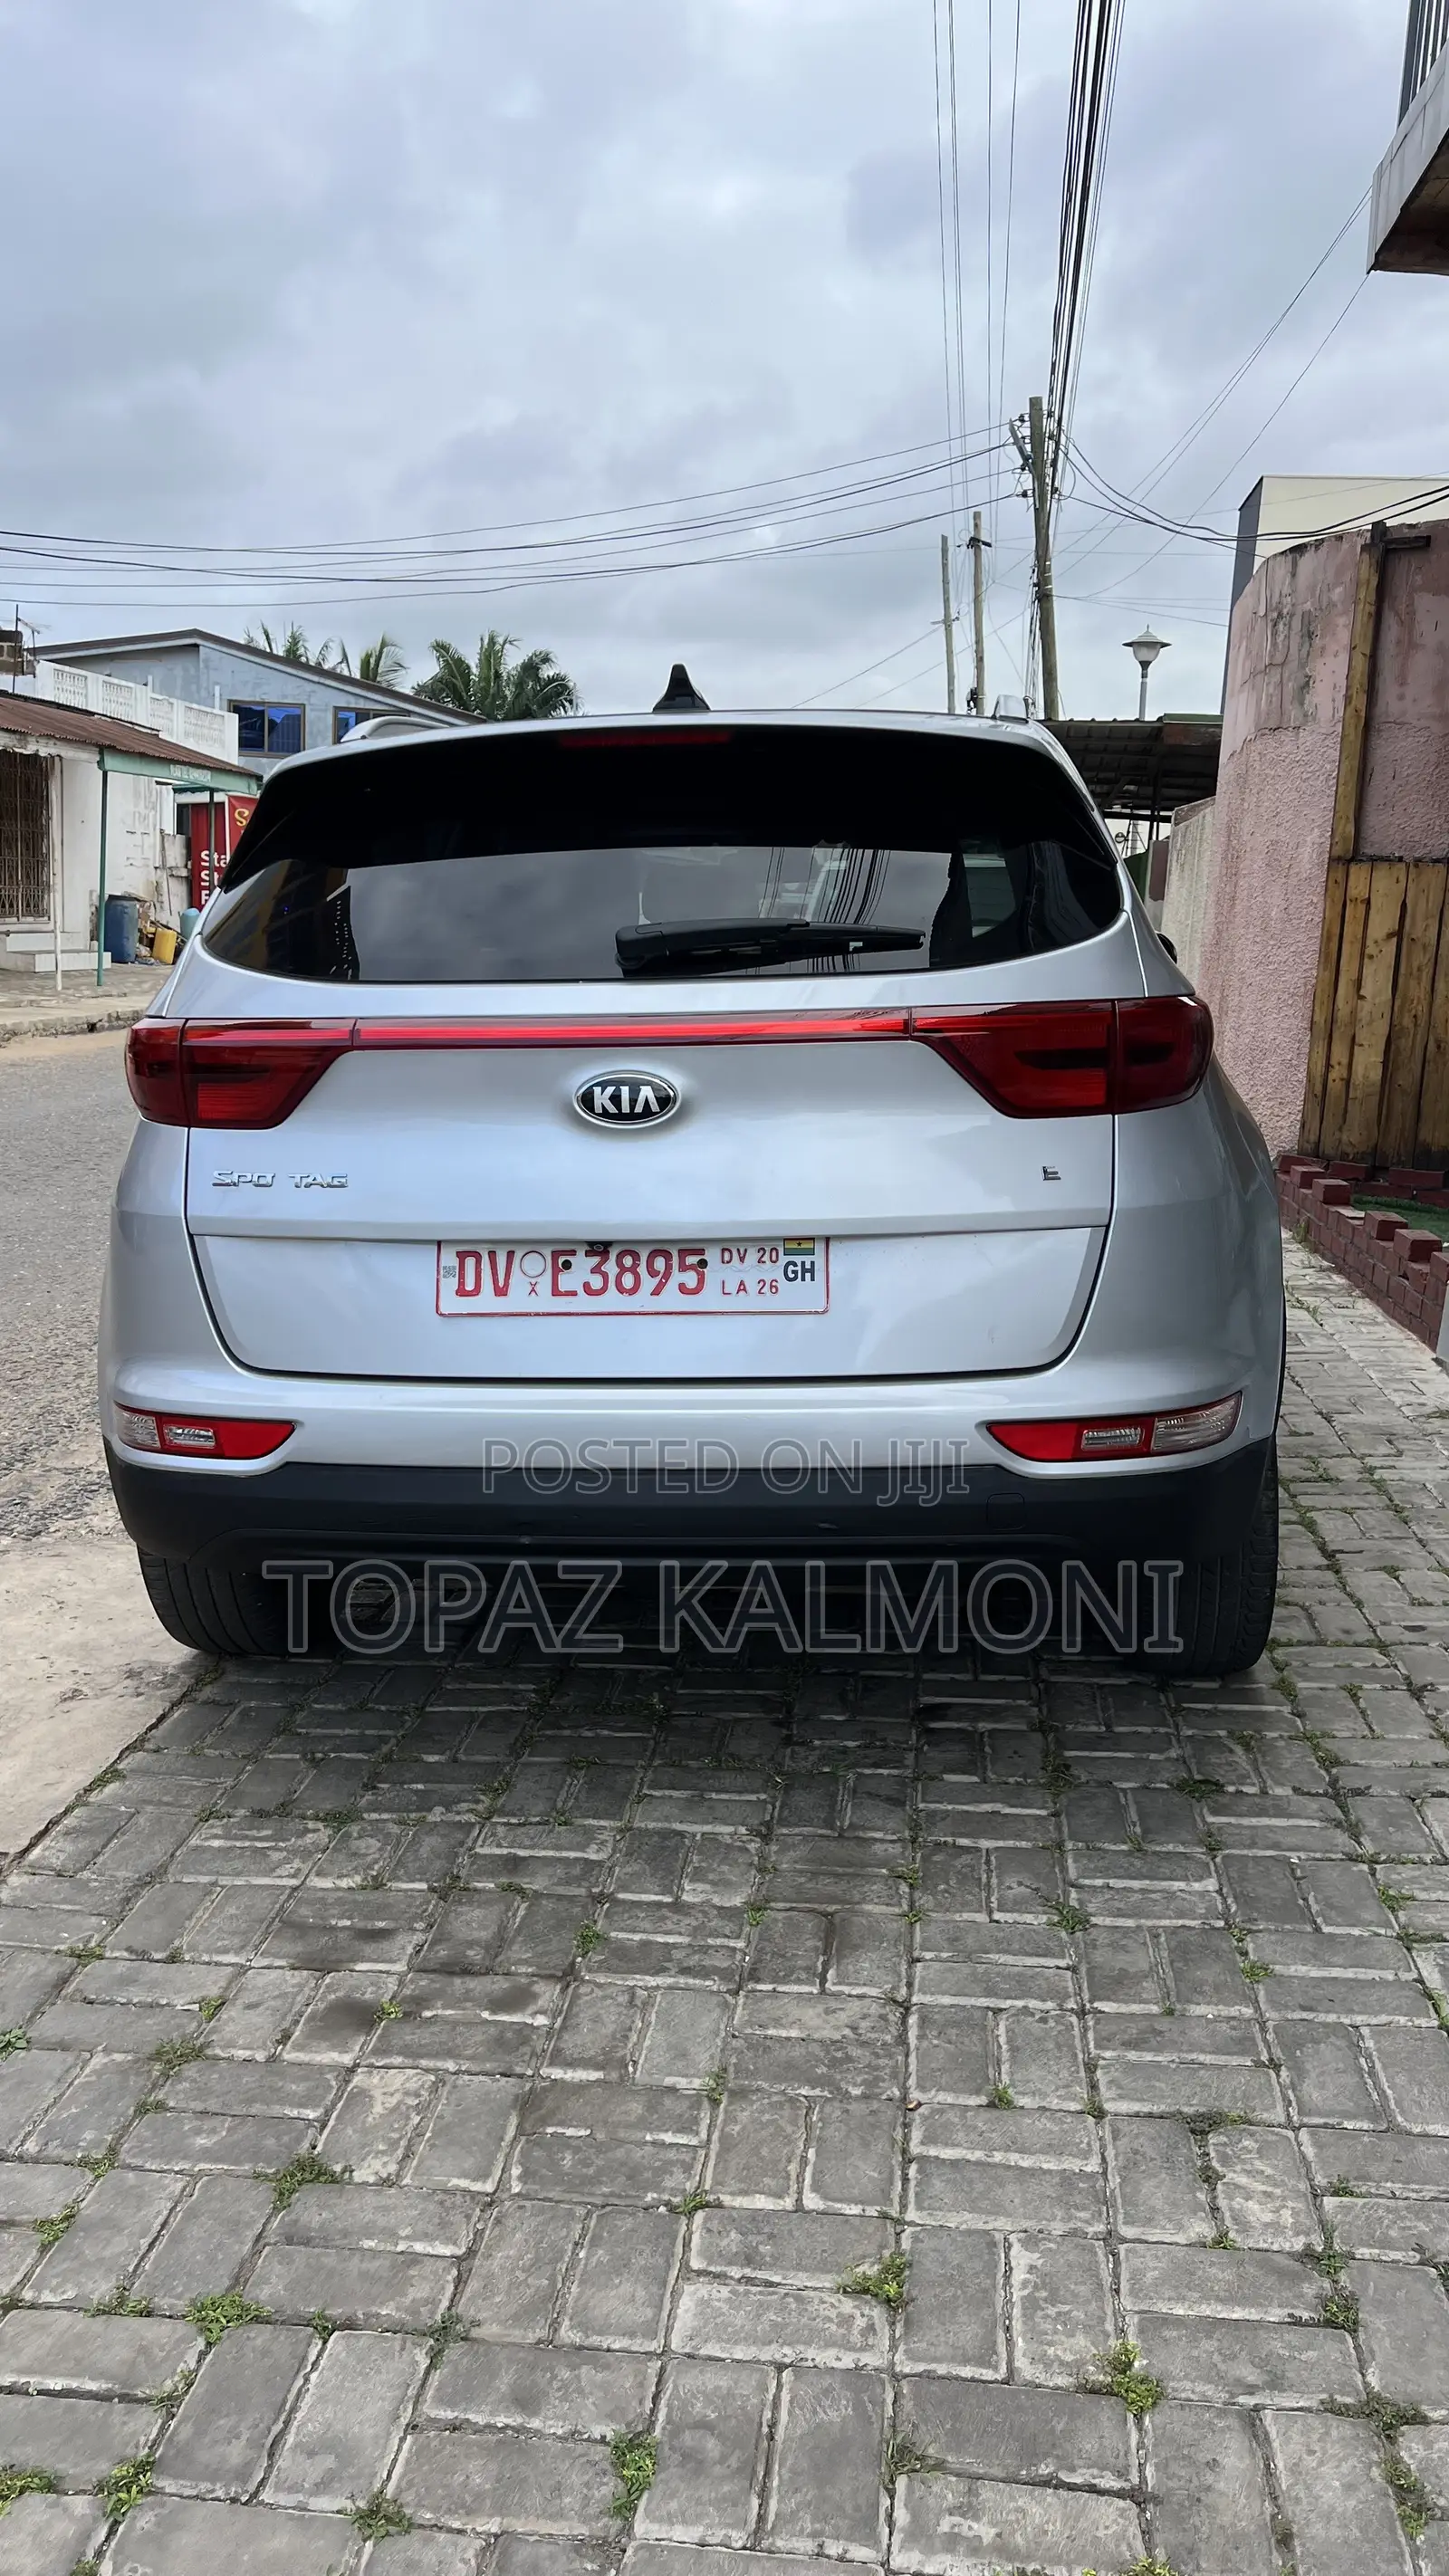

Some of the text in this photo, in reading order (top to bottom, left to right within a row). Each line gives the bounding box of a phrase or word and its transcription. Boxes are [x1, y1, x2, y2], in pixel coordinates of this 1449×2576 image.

[592, 1086, 660, 1114] KIA
[211, 1165, 1061, 1189] SPO TAG E
[721, 1247, 780, 1265] DV 20
[456, 1248, 707, 1297] DV E3895
[783, 1260, 816, 1282] GH
[722, 1278, 779, 1296] LA 26
